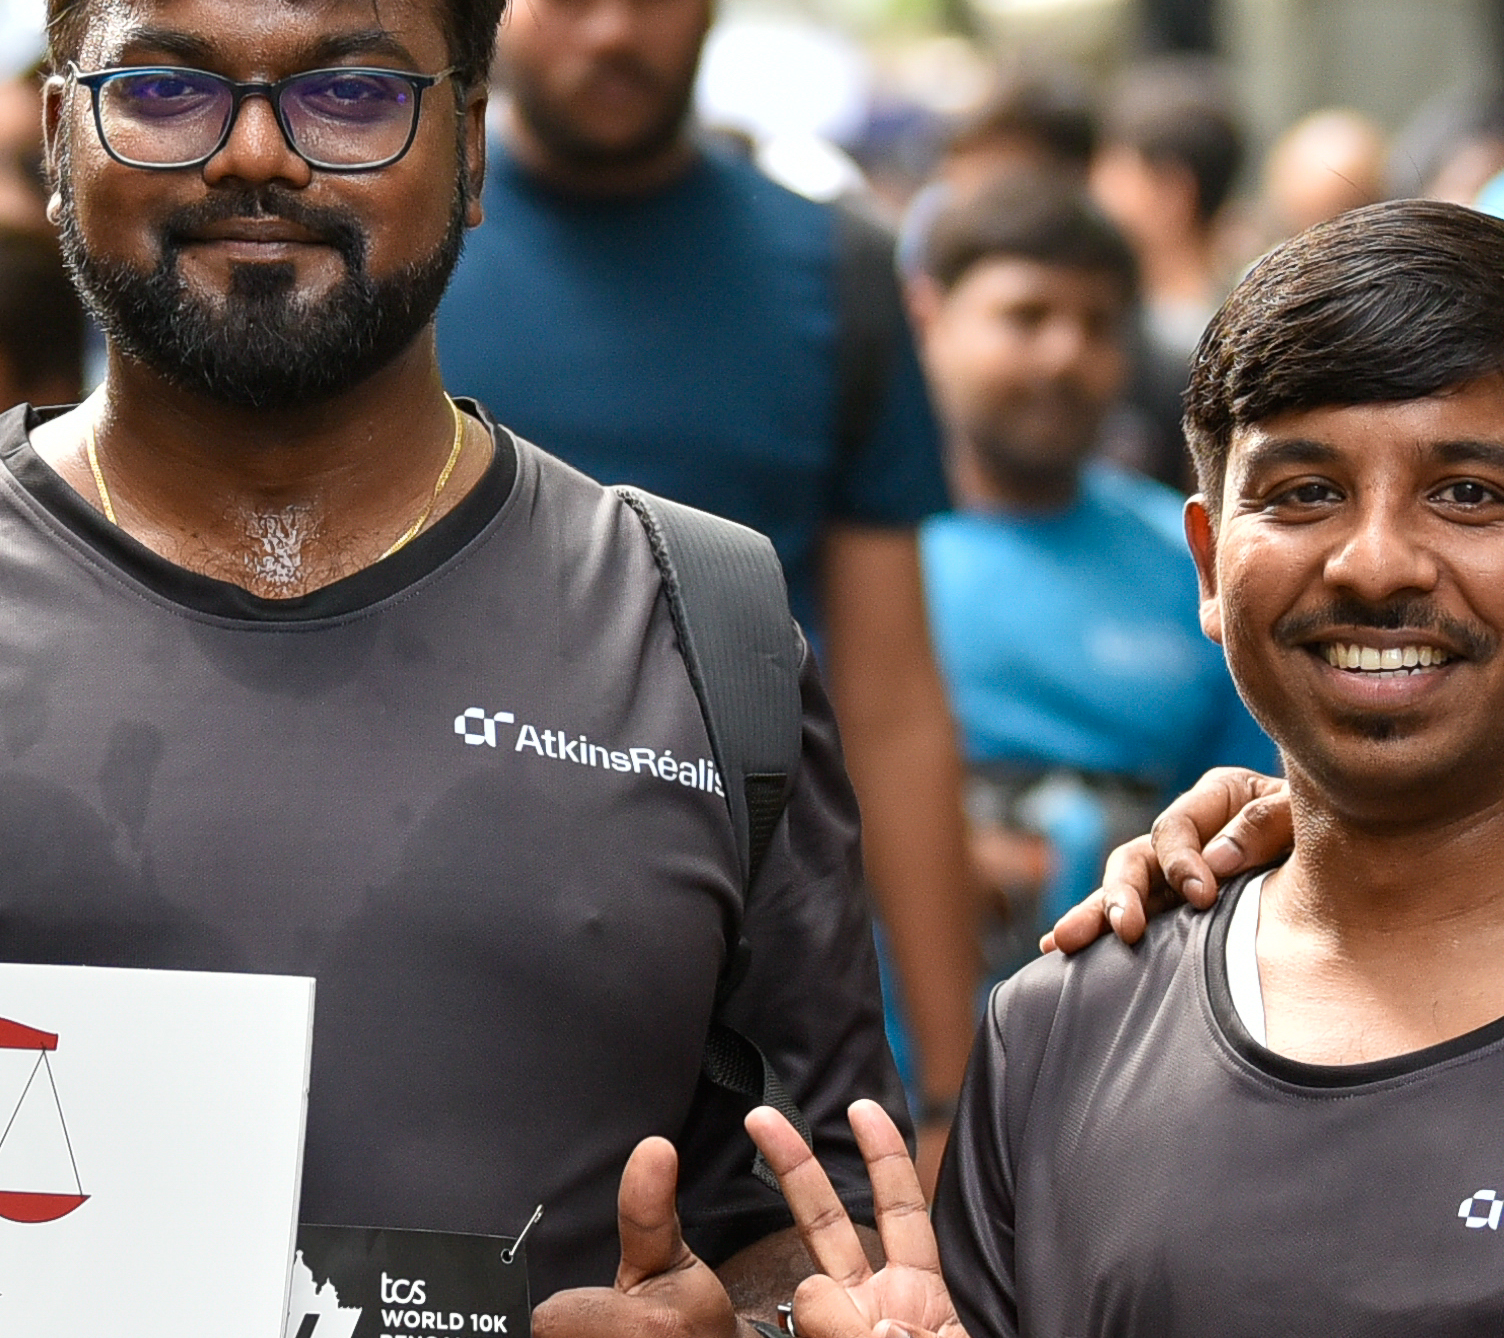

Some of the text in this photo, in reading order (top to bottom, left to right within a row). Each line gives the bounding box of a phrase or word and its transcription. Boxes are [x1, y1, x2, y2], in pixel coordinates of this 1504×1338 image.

[380, 1272, 426, 1305] tcs
[381, 1309, 508, 1334] WORLD 10K
